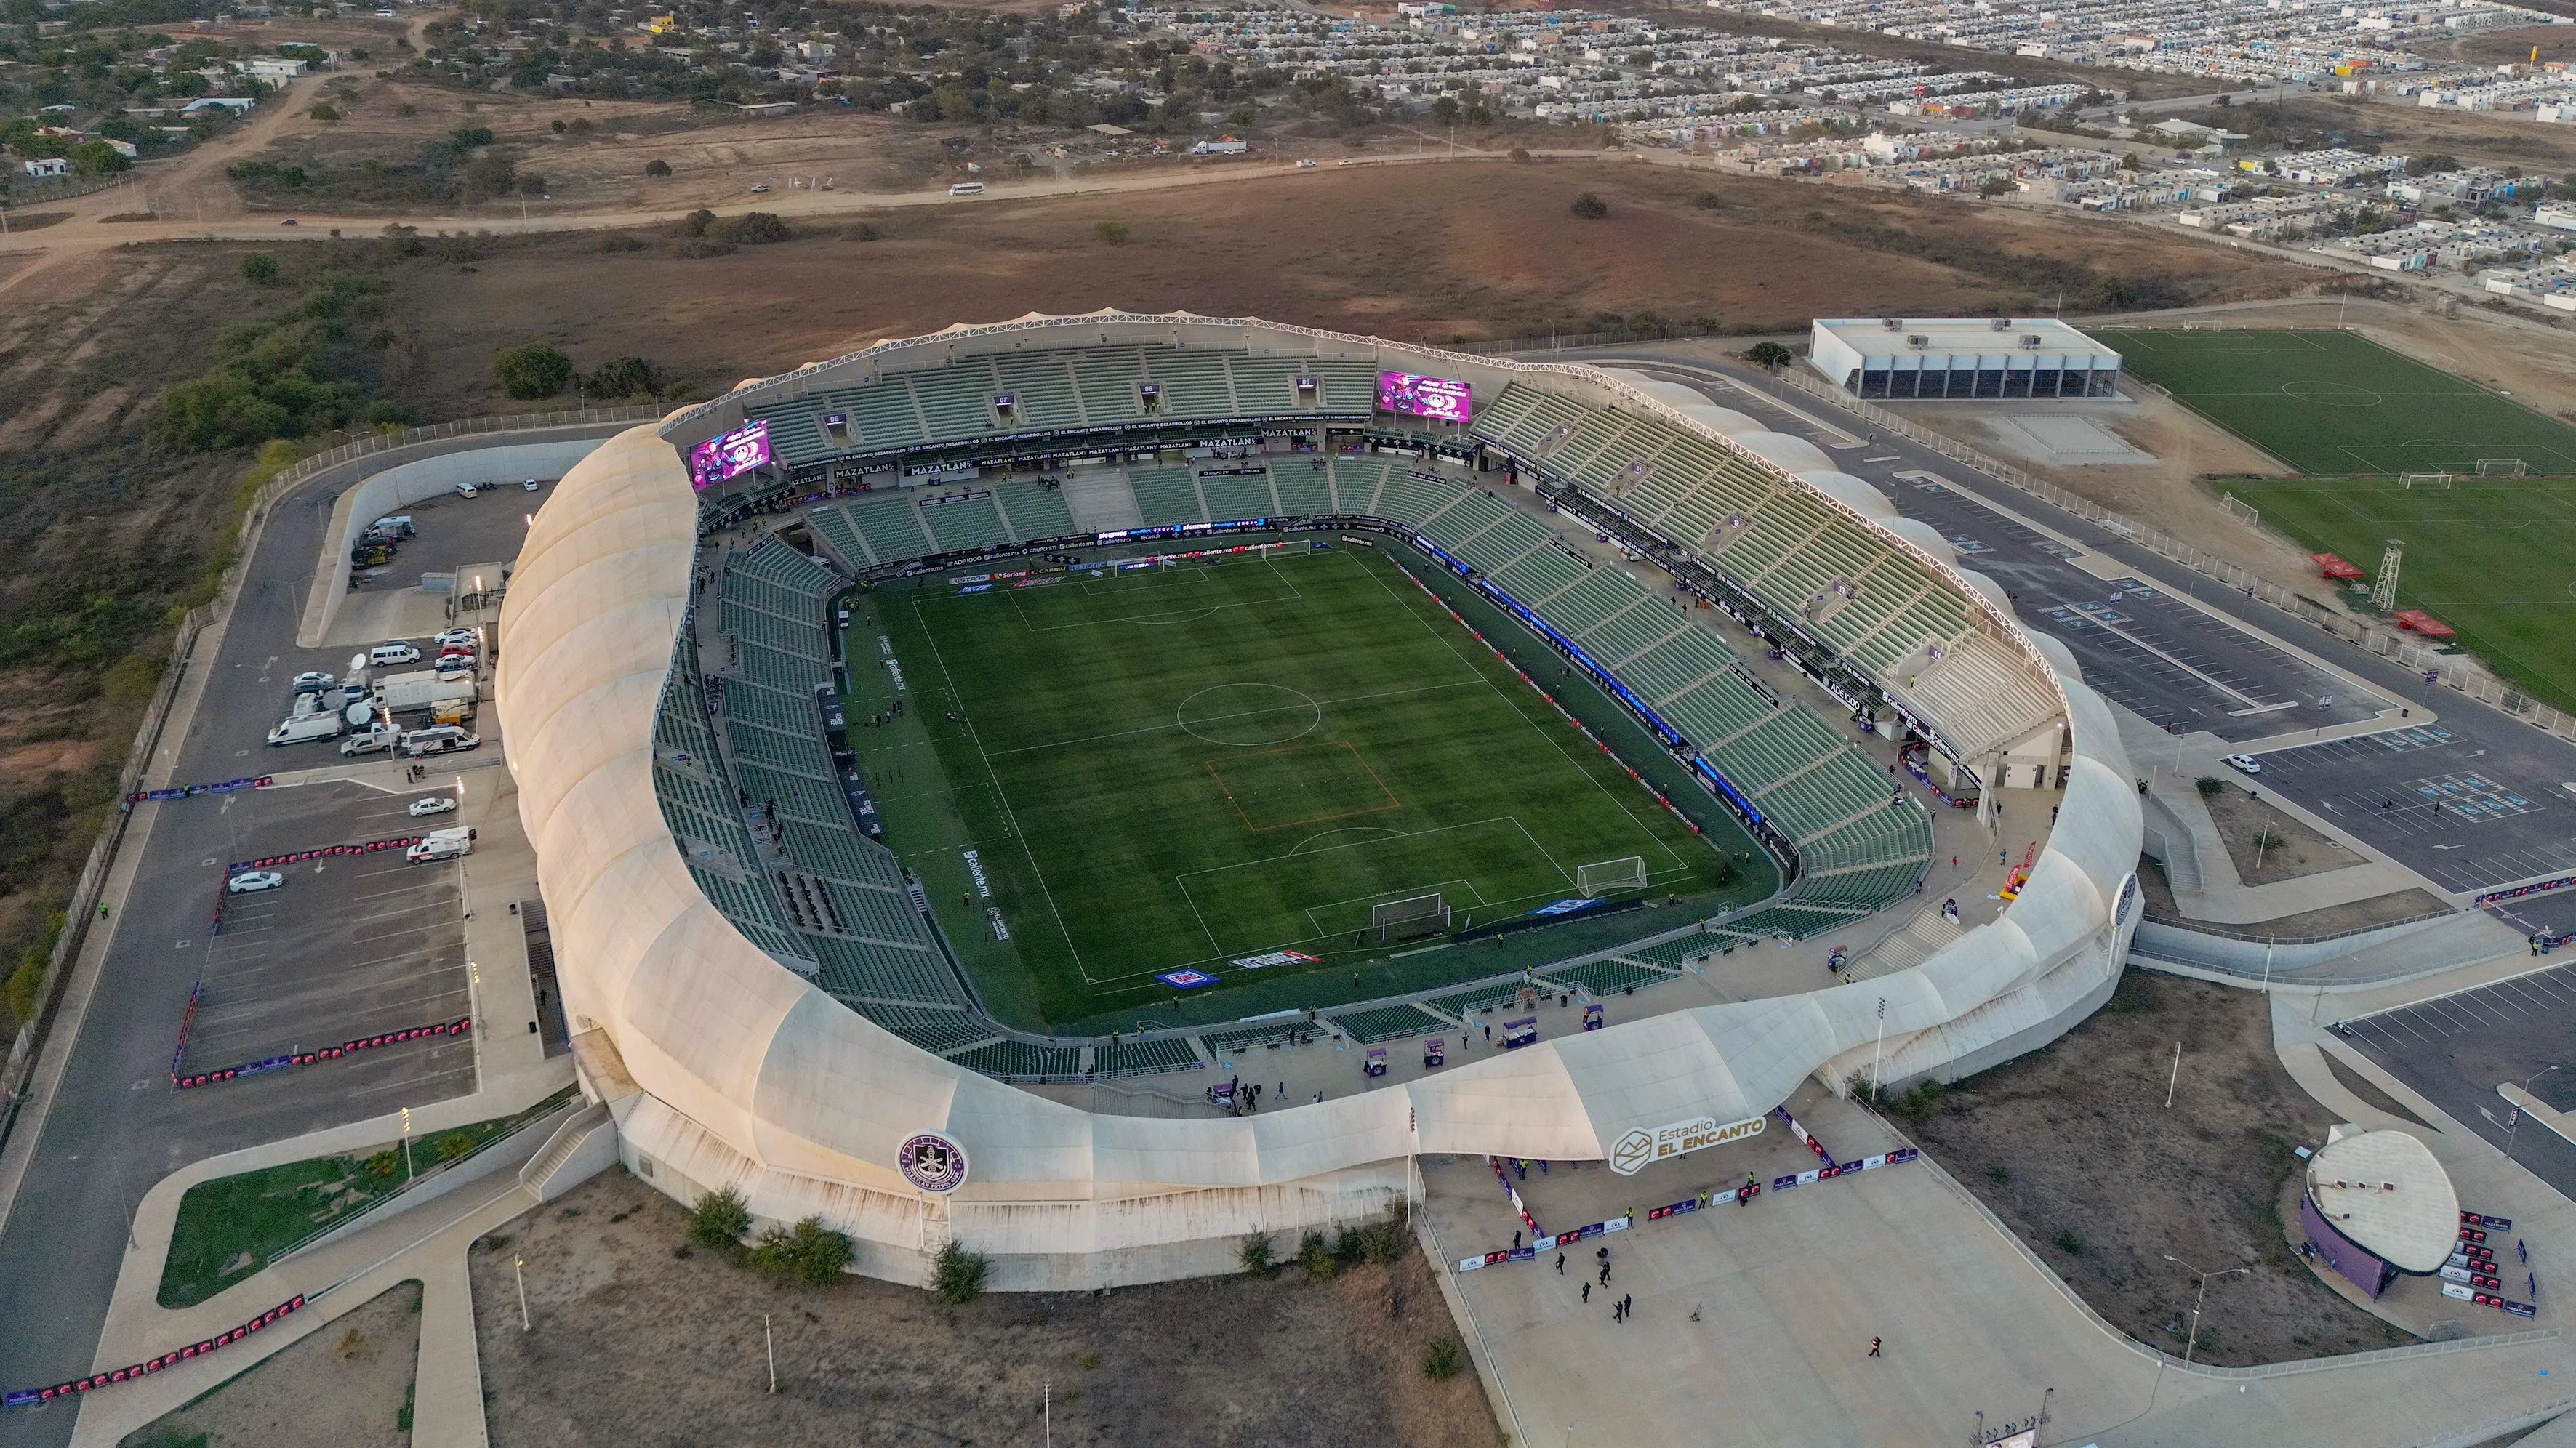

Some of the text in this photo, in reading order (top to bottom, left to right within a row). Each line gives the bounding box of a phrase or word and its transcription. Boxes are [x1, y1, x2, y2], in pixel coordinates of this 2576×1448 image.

[1418, 385, 1466, 397] BIENVENIDOS
[1200, 438, 1251, 447] MAZATLAN
[874, 448, 906, 456] DESARROLLOS
[836, 464, 888, 478] MAZATLAN
[912, 462, 967, 476] MAZATLAN
[1347, 537, 1372, 547] caliente.mx
[990, 550, 1019, 560] caliente.mx
[1200, 547, 1232, 556] caliente.mx
[913, 566, 944, 575] caliente.mx
[1934, 650, 1941, 659] 14
[889, 664, 906, 691] caliente.mx
[1887, 696, 1918, 725] caliente.mx
[1934, 735, 1959, 763] caliente.mx
[1669, 805, 1694, 827] caliente.mx
[968, 857, 991, 898] caliente.mx
[996, 920, 1010, 940] ENCANTO
[1658, 1120, 1713, 1142] Estadio
[1658, 1119, 1763, 1157] EL ENCANTO
[951, 1172, 960, 1183] CLUB
